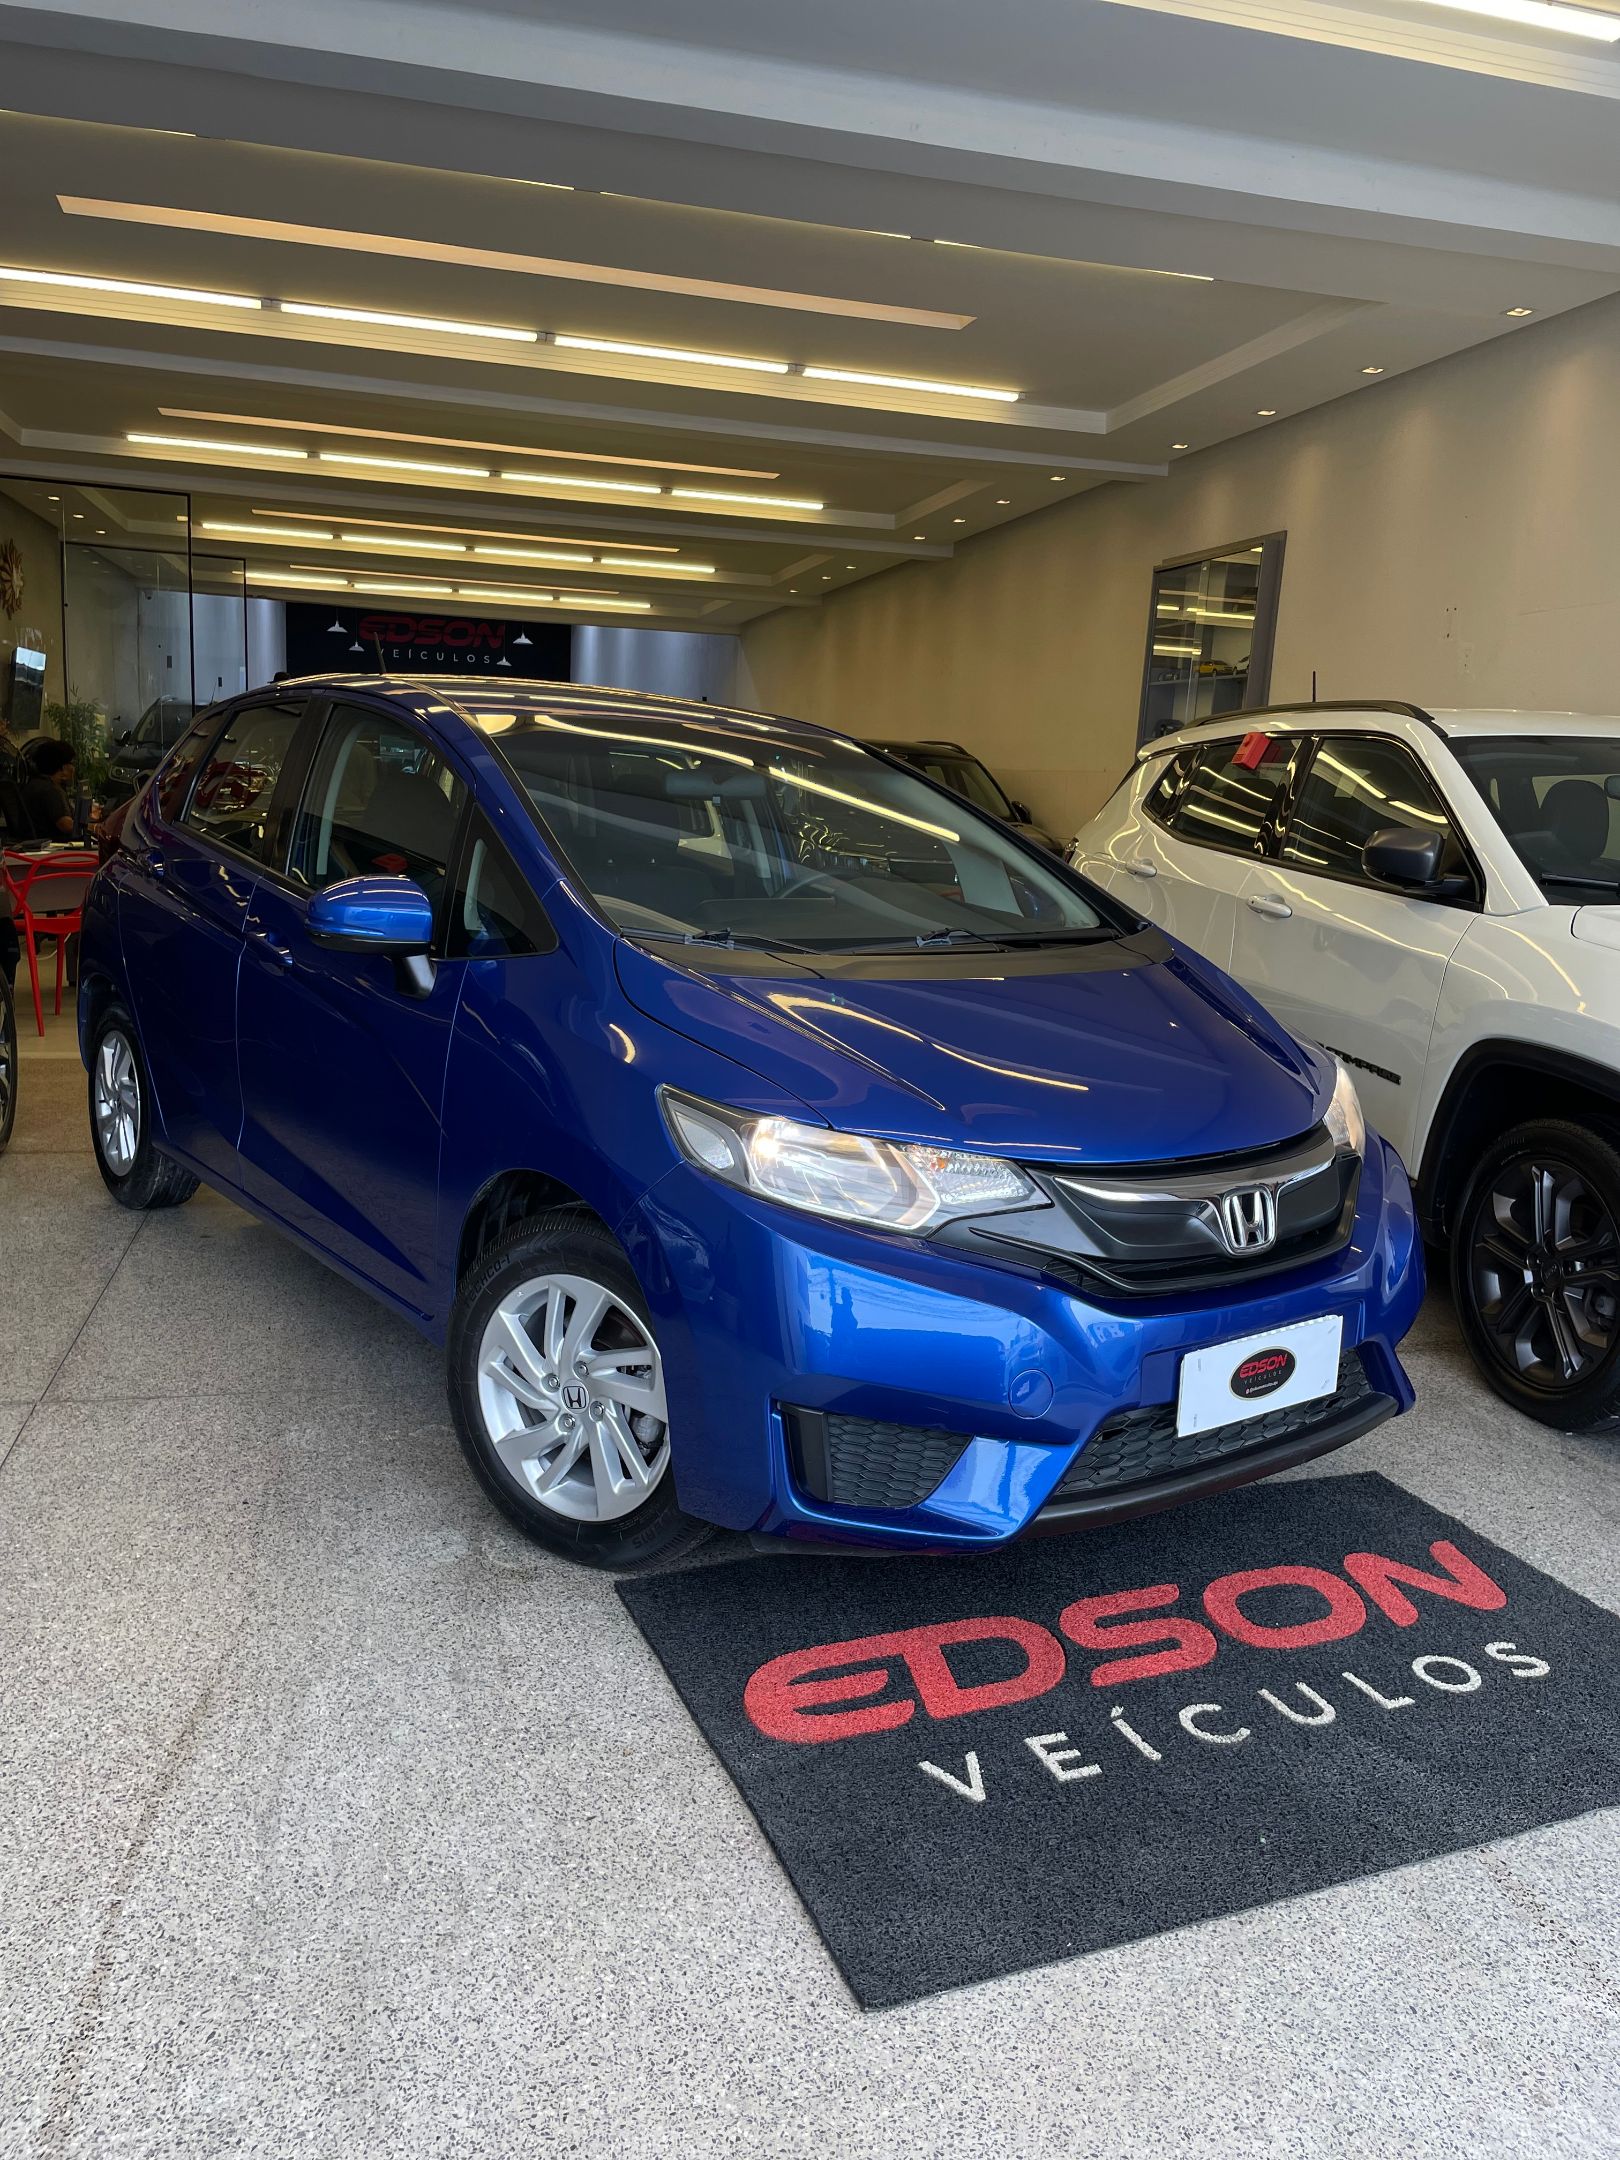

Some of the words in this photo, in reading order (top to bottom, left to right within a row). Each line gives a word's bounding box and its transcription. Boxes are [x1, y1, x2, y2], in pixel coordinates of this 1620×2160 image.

[359, 615, 506, 649] EDSON
[1238, 1353, 1289, 1379] EDSON
[743, 1540, 1508, 1745] EDSON
[918, 1641, 1552, 1803] VEÍCULOS
